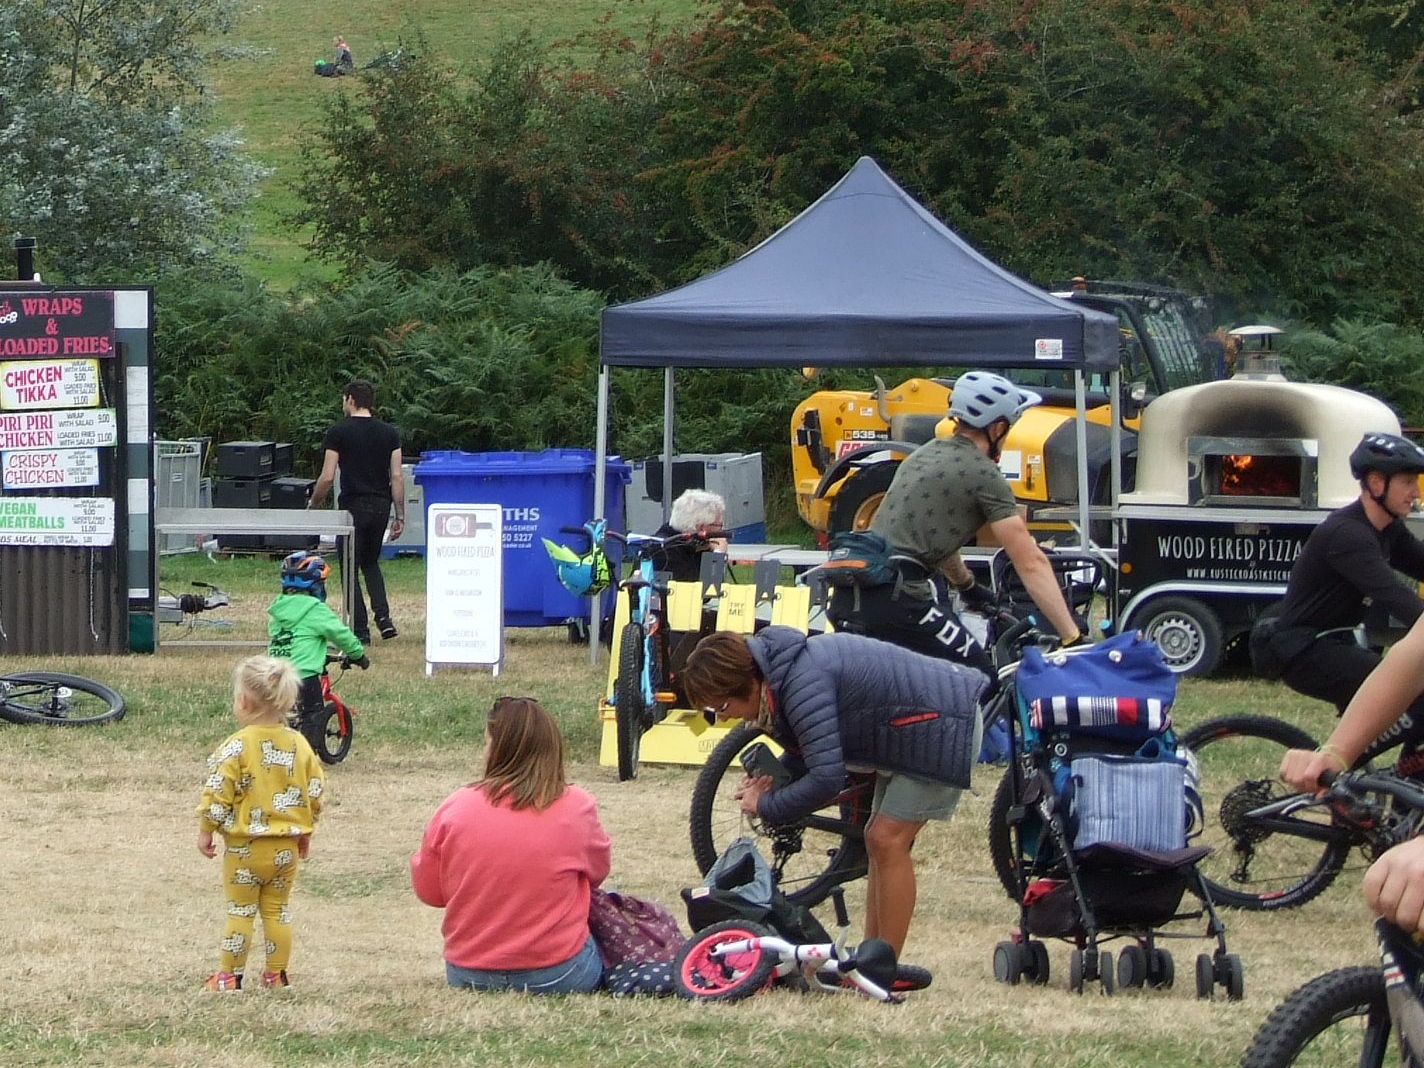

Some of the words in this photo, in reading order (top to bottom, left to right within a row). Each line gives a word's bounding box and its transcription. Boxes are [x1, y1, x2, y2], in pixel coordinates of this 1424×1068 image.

[22, 298, 83, 316] WRAPS
[45, 318, 59, 334] &
[63, 337, 109, 354] FRIES
[6, 366, 62, 388] CHICKEN
[16, 385, 57, 404] TIKKA
[73, 395, 88, 405] 11.00
[27, 415, 53, 431] PIRI
[98, 413, 110, 423] 9.00
[97, 432, 113, 442] 11.00
[9, 454, 58, 468] CRISPY
[5, 469, 64, 485] CHICKEN
[502, 507, 540, 521] THS
[14, 535, 37, 543] MEAL
[514, 533, 533, 542] 5227
[1158, 536, 1204, 559] WOOD
[1210, 538, 1254, 560] FIRED
[1259, 539, 1302, 561] PIZZA
[729, 608, 744, 616] ME
[918, 607, 975, 657] FOX
